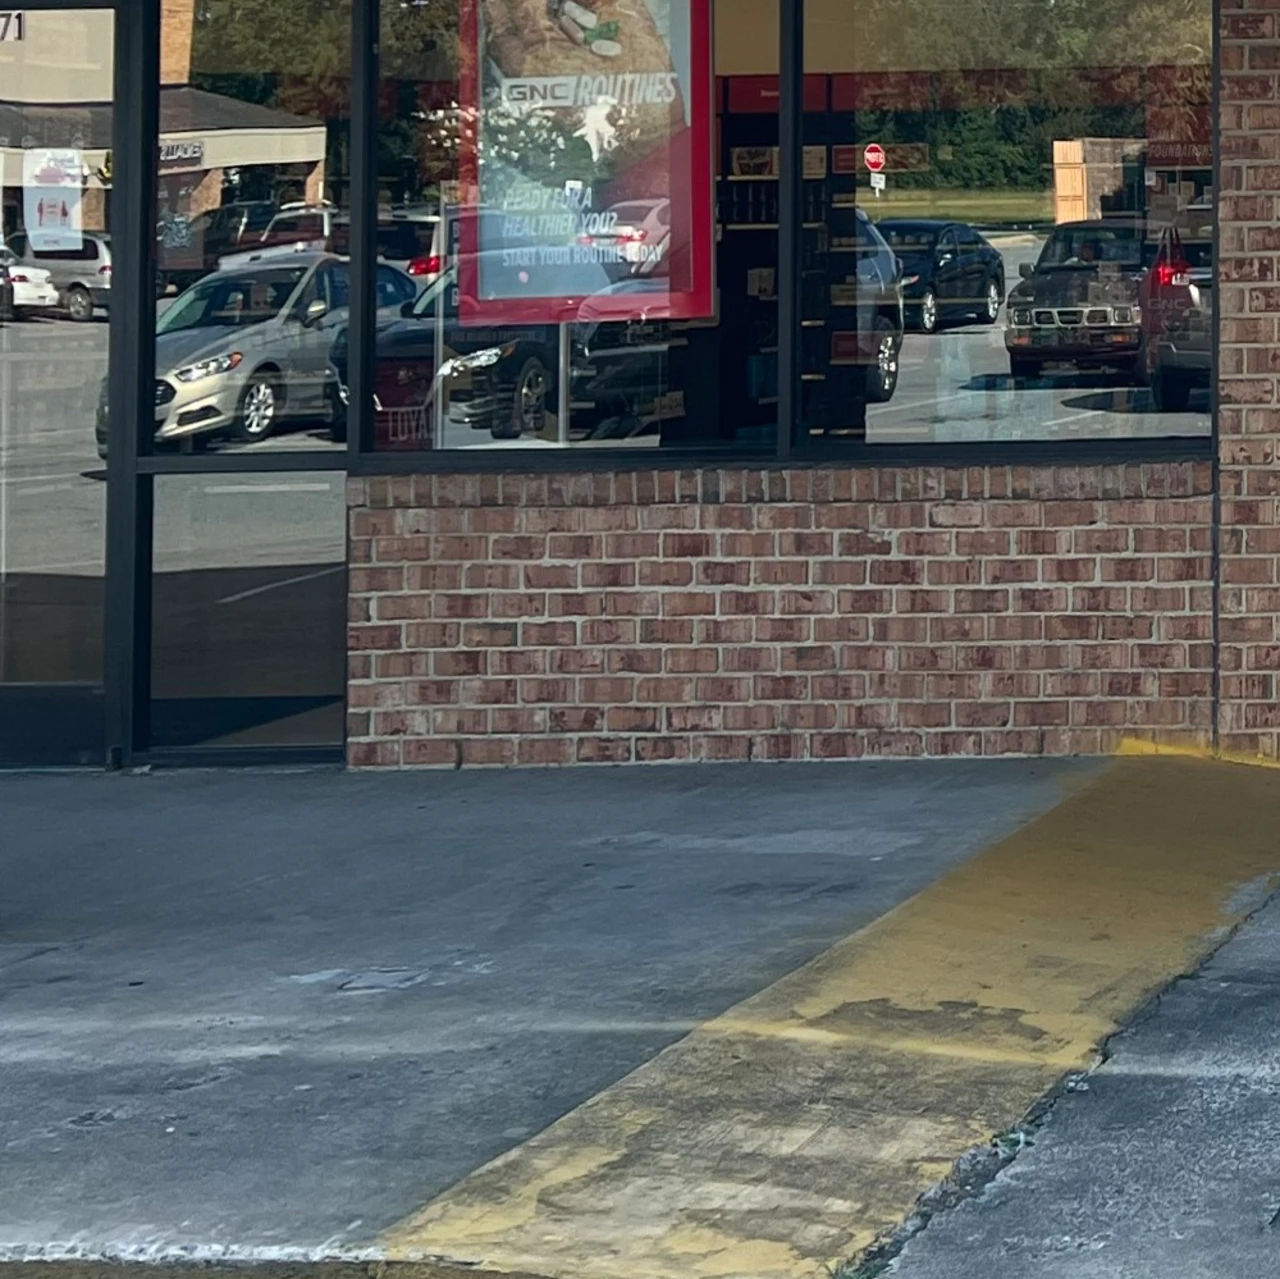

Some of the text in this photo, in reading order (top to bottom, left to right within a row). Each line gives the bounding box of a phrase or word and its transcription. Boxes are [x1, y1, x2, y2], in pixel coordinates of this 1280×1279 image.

[508, 73, 678, 106] GNC ROUTINES
[579, 212, 618, 235] YOU?
[503, 247, 537, 267] START
[539, 247, 571, 266] YOUR
[573, 245, 624, 264] ROUTINE
